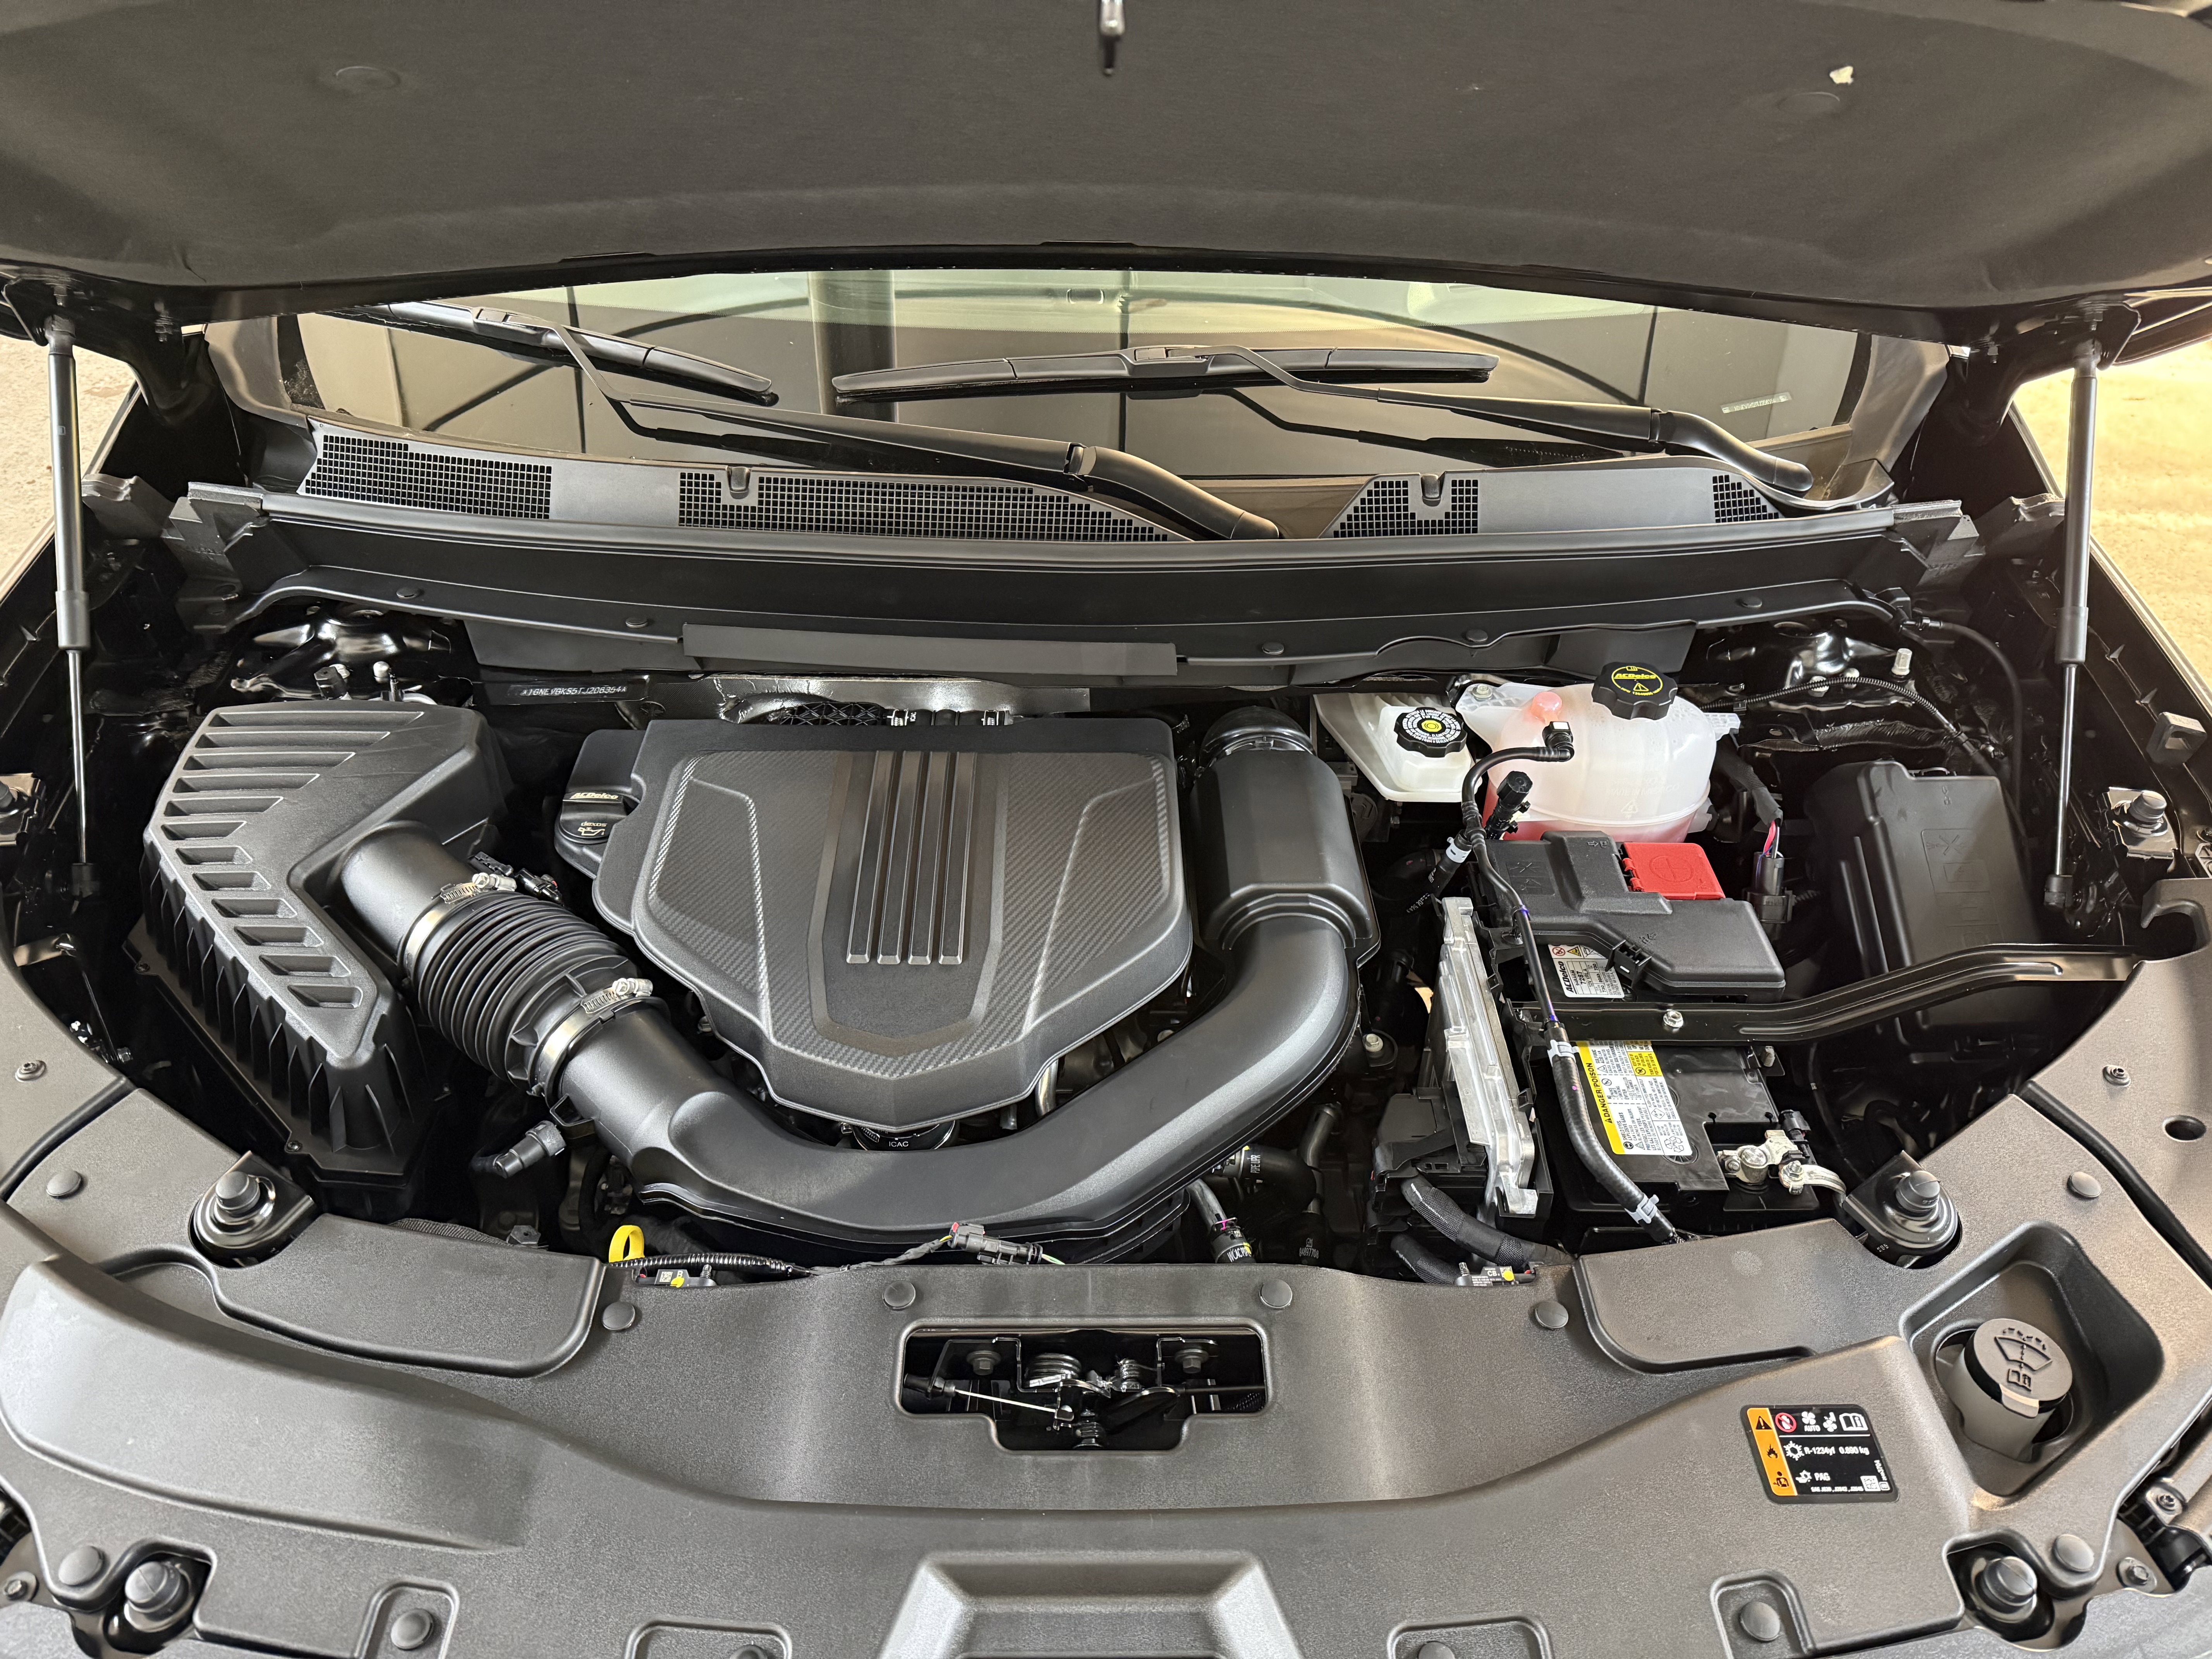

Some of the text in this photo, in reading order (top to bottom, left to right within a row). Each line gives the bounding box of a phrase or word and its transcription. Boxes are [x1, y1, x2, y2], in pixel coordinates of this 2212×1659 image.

[1558, 961, 1574, 993] ACDelco
[1576, 971, 1586, 984] 7287
[1586, 1063, 1610, 1117] DANGER/POISON
[1804, 1446, 1836, 1456] R-1234yf
[1859, 1446, 1870, 1455] kg
[1814, 1472, 1831, 1481] PAG
